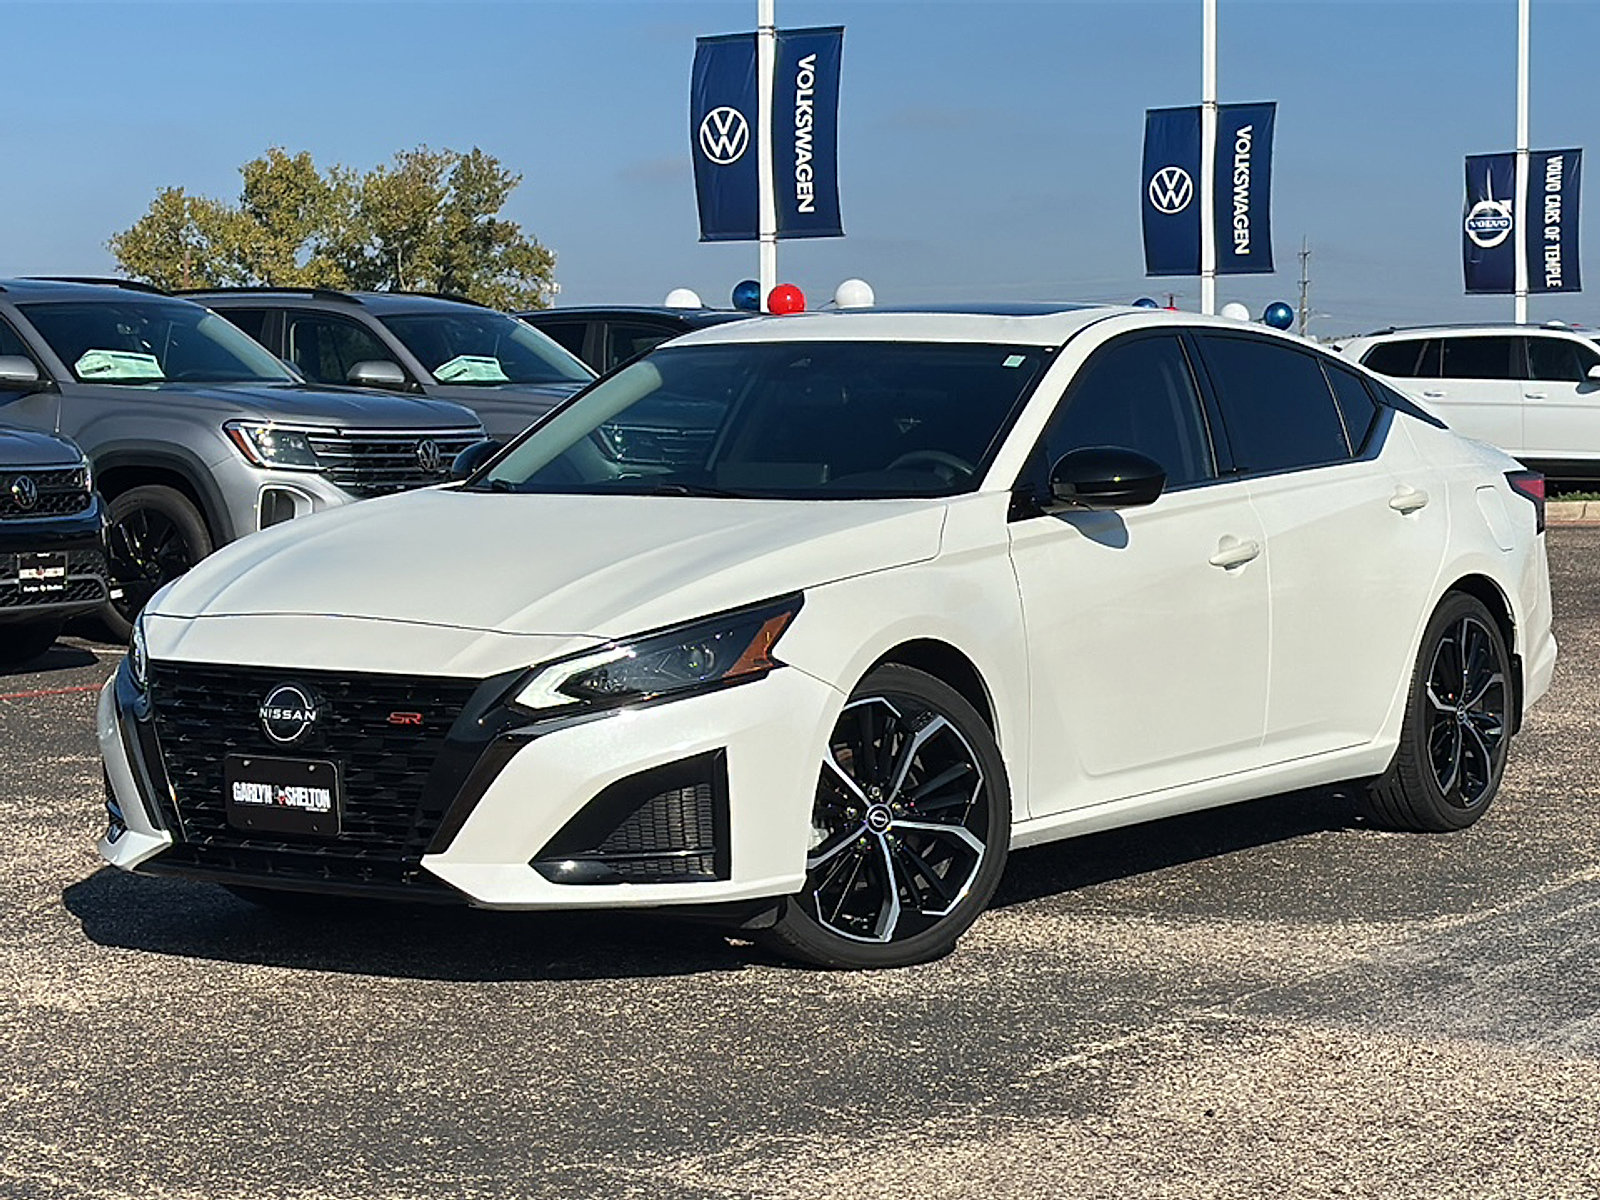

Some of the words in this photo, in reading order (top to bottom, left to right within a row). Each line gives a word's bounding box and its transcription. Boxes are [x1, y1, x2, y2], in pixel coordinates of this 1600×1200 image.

[795, 53, 817, 213] VOLKSWAGEN
[1545, 155, 1563, 192] VOLVO
[1233, 125, 1253, 255] VOLKSWAGEN
[1544, 194, 1561, 224] CARS
[1470, 220, 1508, 228] VOLVO
[1544, 226, 1561, 241] OF
[1544, 243, 1562, 288] TEMPLE
[259, 707, 317, 722] NISSAN
[387, 711, 424, 725] SR
[232, 781, 273, 805] GARLYN
[284, 786, 331, 808] SHELTON
